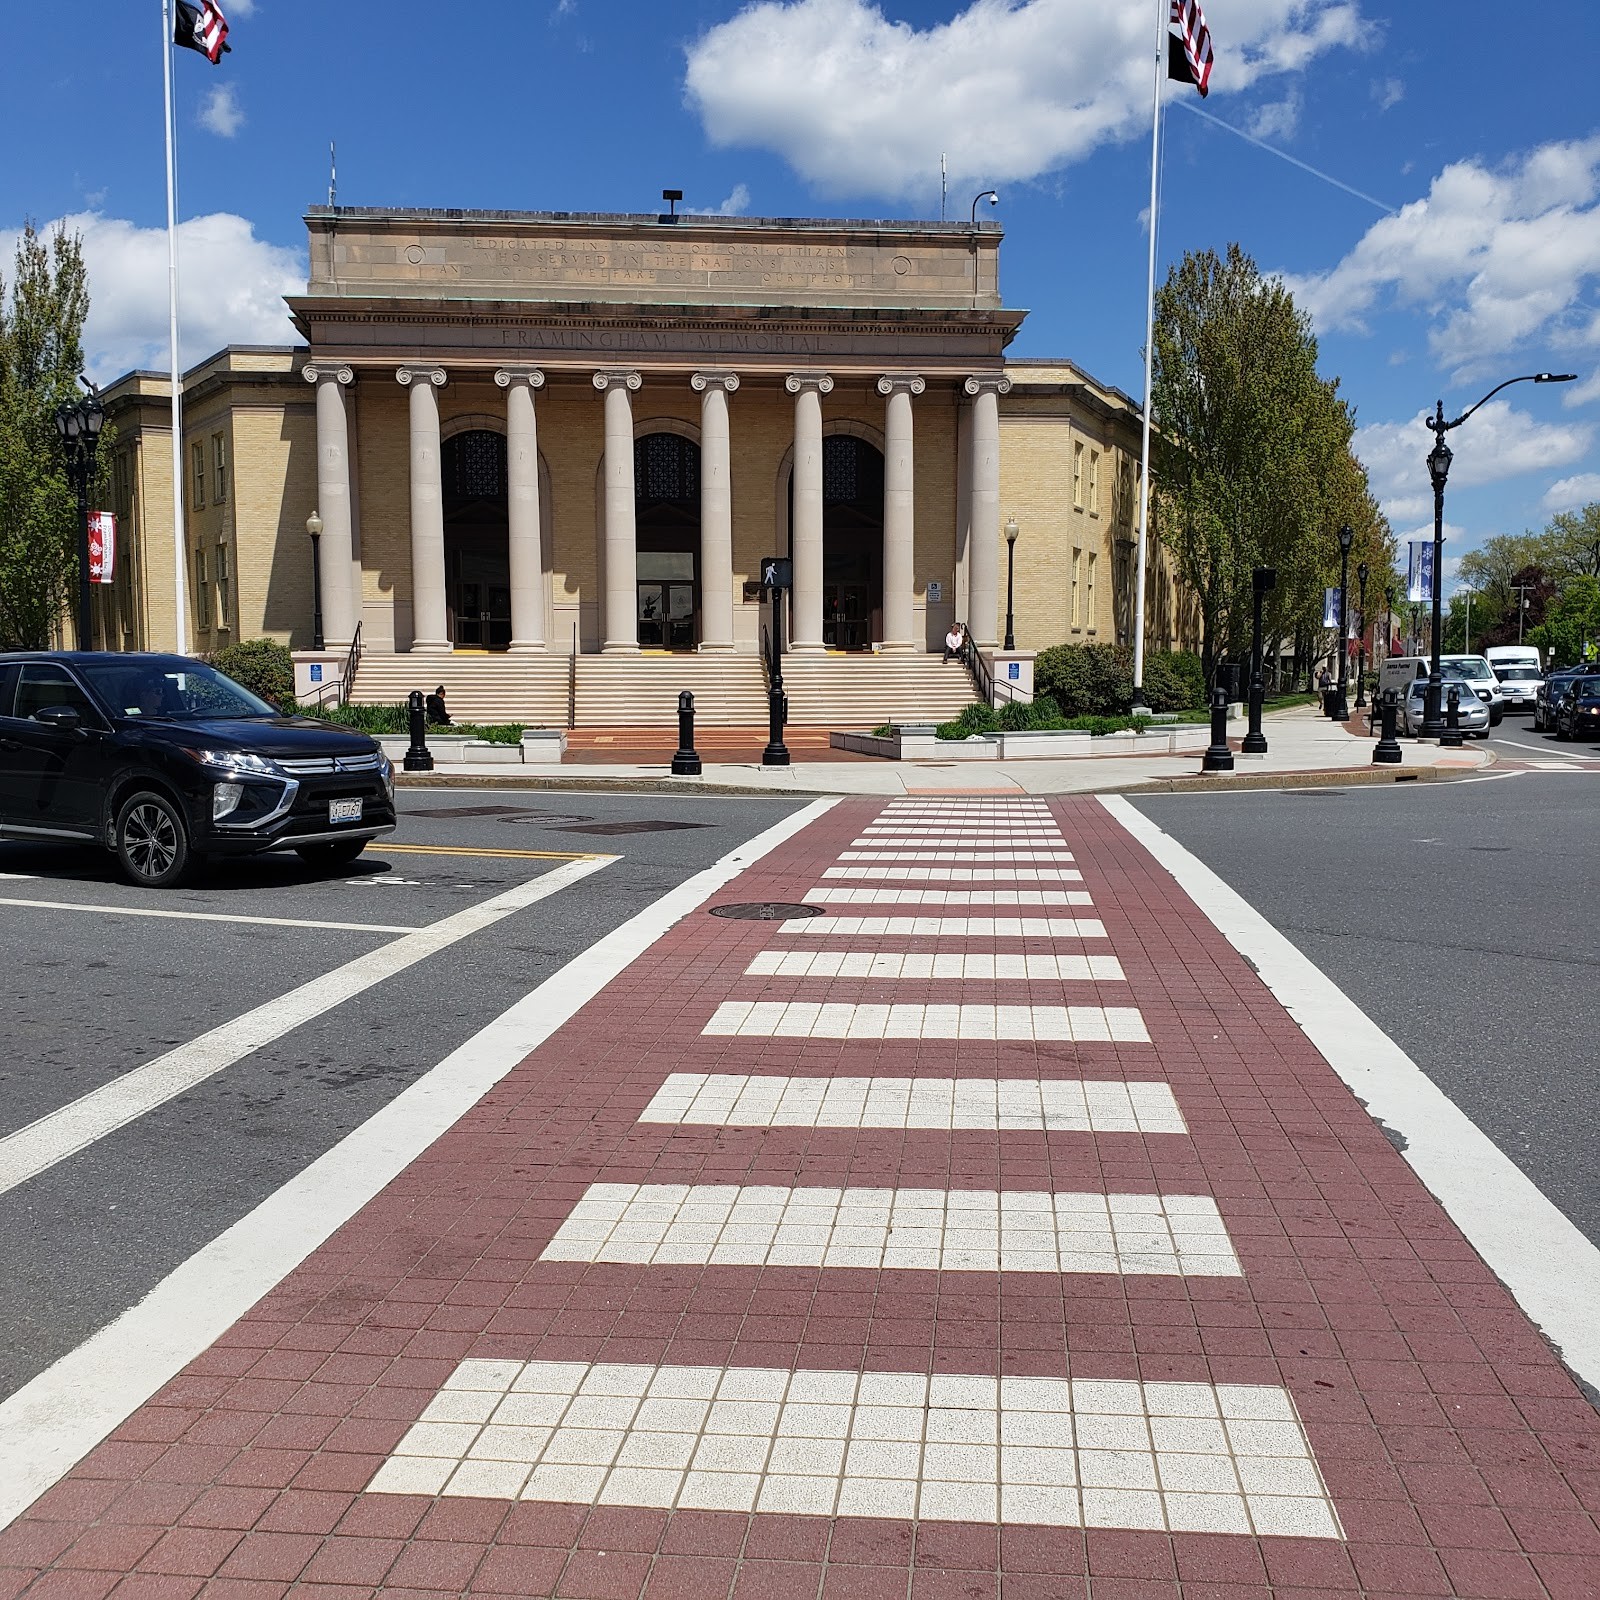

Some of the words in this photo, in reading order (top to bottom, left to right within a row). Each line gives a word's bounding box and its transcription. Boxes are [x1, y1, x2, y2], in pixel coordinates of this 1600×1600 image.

[463, 239, 564, 251] DEDICATED
[582, 242, 597, 250] IN
[615, 242, 673, 253] HONOR
[776, 247, 855, 258] CITIZENS
[484, 252, 520, 262] WHO
[537, 253, 606, 265] SERVED
[624, 256, 639, 265] IN
[655, 256, 686, 267] THE
[701, 257, 776, 269] NATONS
[794, 260, 835, 270] WARS
[440, 265, 472, 275] AND
[576, 268, 655, 279] WELFARE
[763, 273, 794, 283] OUR
[811, 273, 877, 284] PEOPLE
[502, 330, 667, 348] FRAMINGHAM
[699, 334, 826, 350] MEMORIAL
